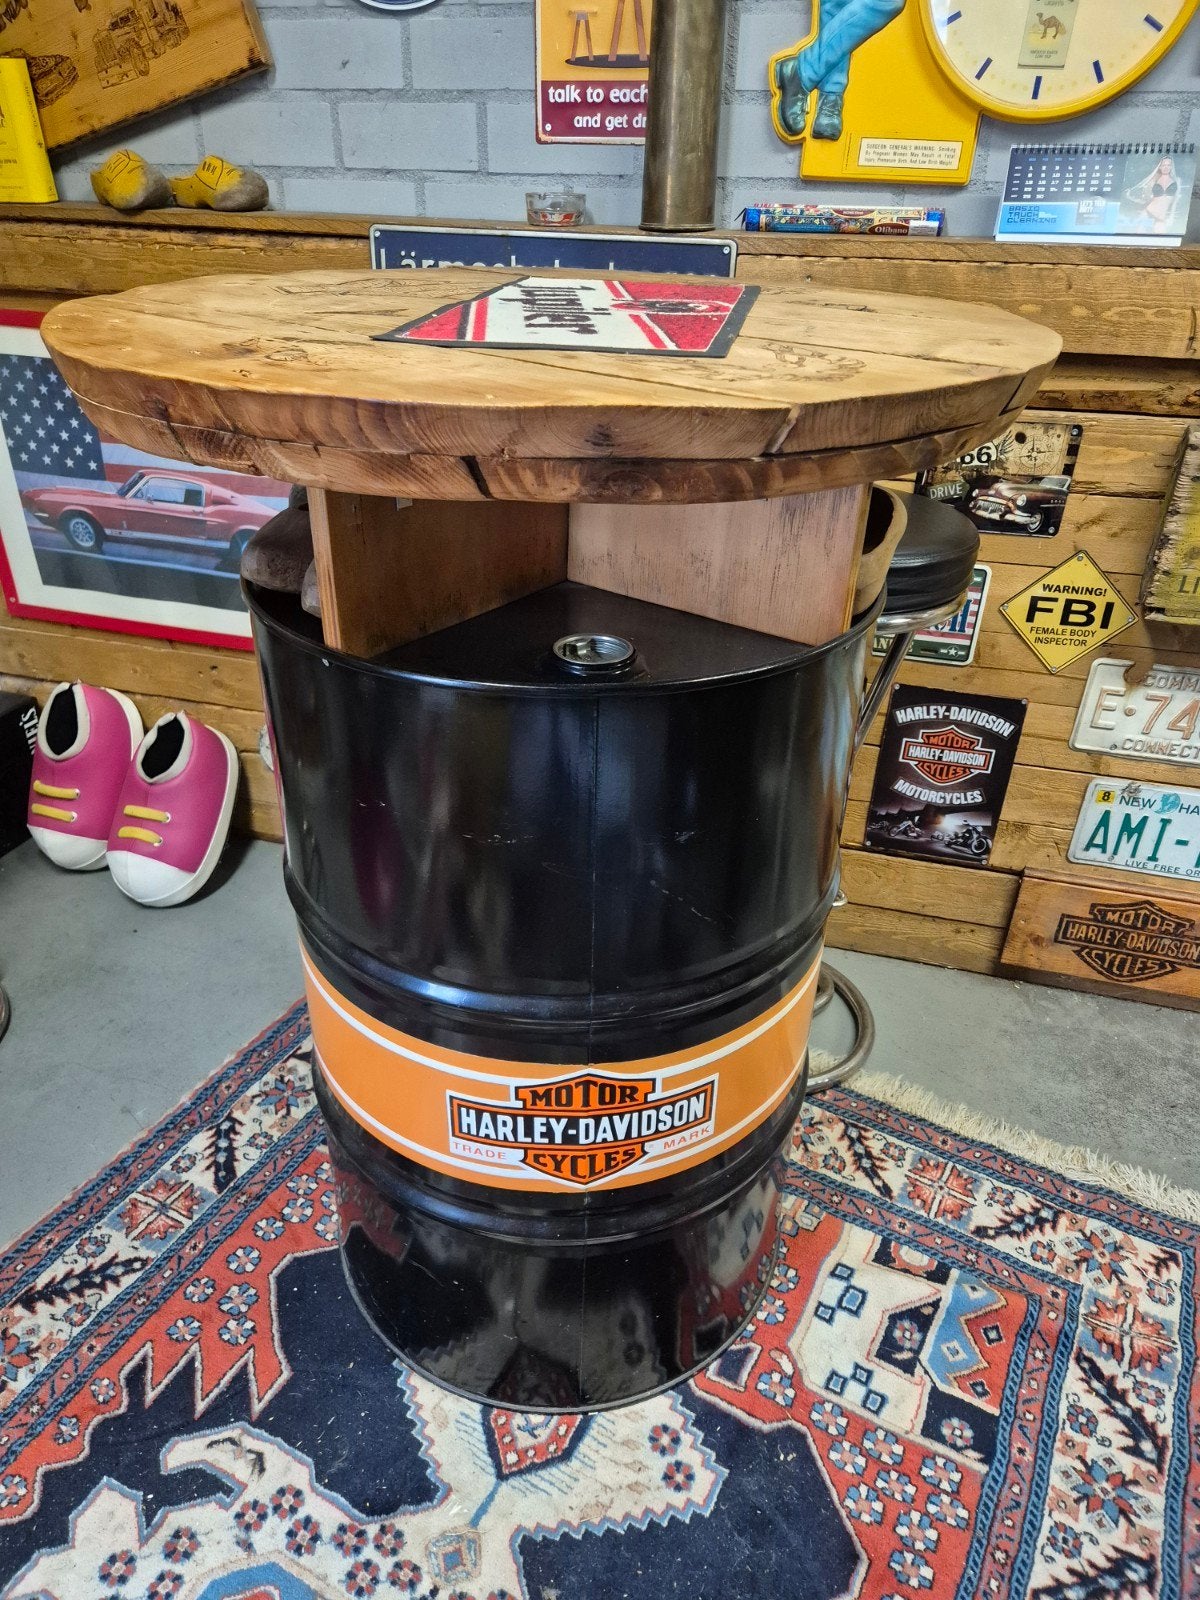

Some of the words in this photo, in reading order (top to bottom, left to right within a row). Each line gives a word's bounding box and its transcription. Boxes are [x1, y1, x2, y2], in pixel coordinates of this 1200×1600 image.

[547, 84, 582, 103] talk
[586, 86, 605, 103] to
[573, 113, 601, 128] and
[605, 114, 628, 131] get
[930, 483, 963, 499] DRIVE
[1042, 583, 1107, 597] WARNING!
[1025, 596, 1115, 630] FBI
[1030, 626, 1067, 637] FEMALE
[1069, 629, 1097, 639] BODY
[1034, 636, 1088, 647] INSPECTOR
[1143, 673, 1200, 693] COMM
[895, 705, 1015, 737] HARLEY-DAVIDSON
[929, 733, 972, 749] MOTOR
[908, 745, 986, 767] HARLEY-DAVIDSON
[925, 763, 964, 779] CYCLES
[893, 779, 983, 805] MOTORCYCLES
[1102, 791, 1112, 801] 8
[1119, 795, 1157, 809] NEW
[1083, 810, 1200, 868] AMI-
[1125, 859, 1148, 869] LIVE
[1154, 864, 1181, 874] FREE
[1106, 908, 1176, 934] MOTOR
[1066, 921, 1200, 960] HARLEY-DAVIDSON
[1091, 949, 1159, 976] CYCLES
[529, 1079, 640, 1108] MOTOR
[460, 1092, 706, 1145] HARLEY-DAVIDSON
[453, 1141, 507, 1160] TRADE
[663, 1125, 711, 1150] MARK
[533, 1148, 637, 1179] CYCLES
